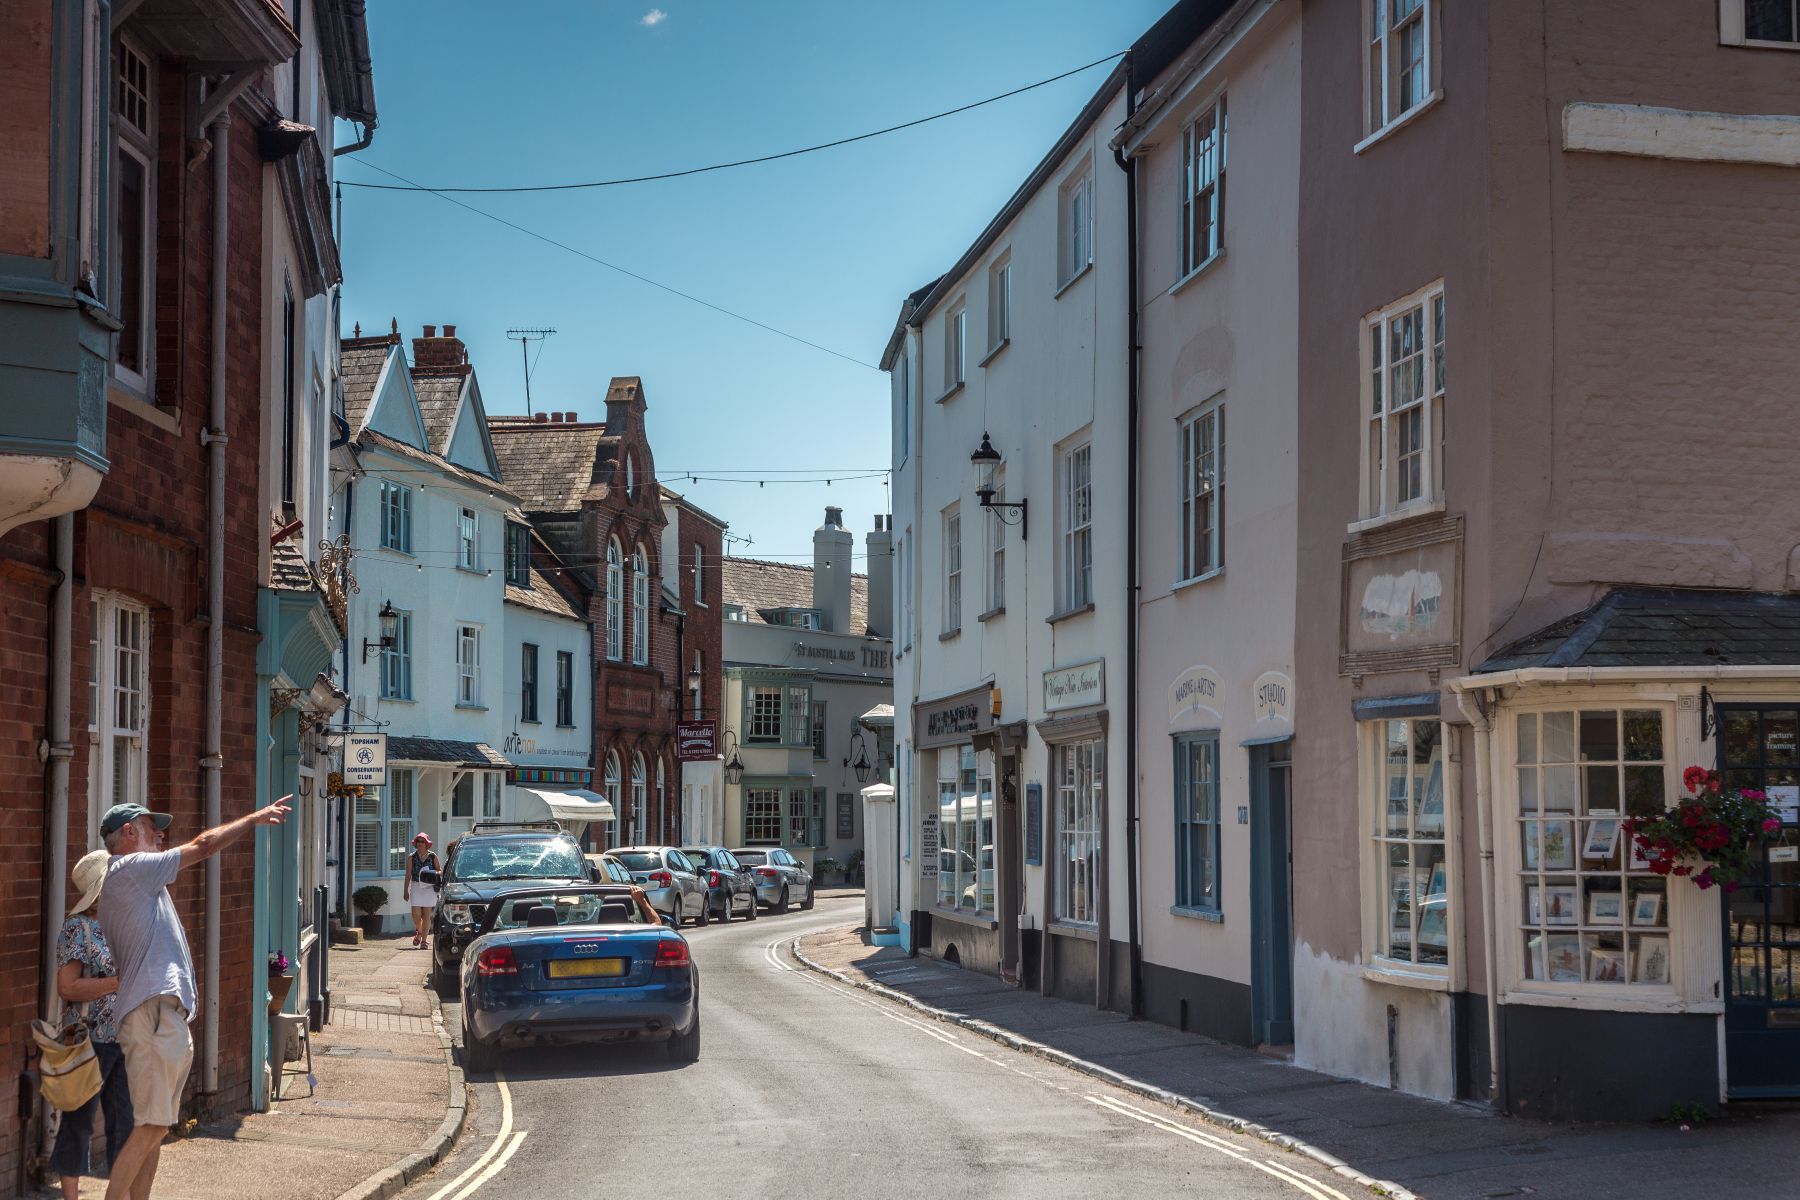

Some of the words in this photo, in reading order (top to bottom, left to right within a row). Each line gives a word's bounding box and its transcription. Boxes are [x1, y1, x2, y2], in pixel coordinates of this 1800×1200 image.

[861, 645, 888, 669] THE
[1175, 679, 1194, 705] MARINE
[1197, 677, 1216, 699] ARTIST
[1259, 683, 1286, 708] STUDIO
[680, 727, 713, 737] Marcello
[1768, 731, 1794, 742] picture
[1766, 741, 1797, 752] framing
